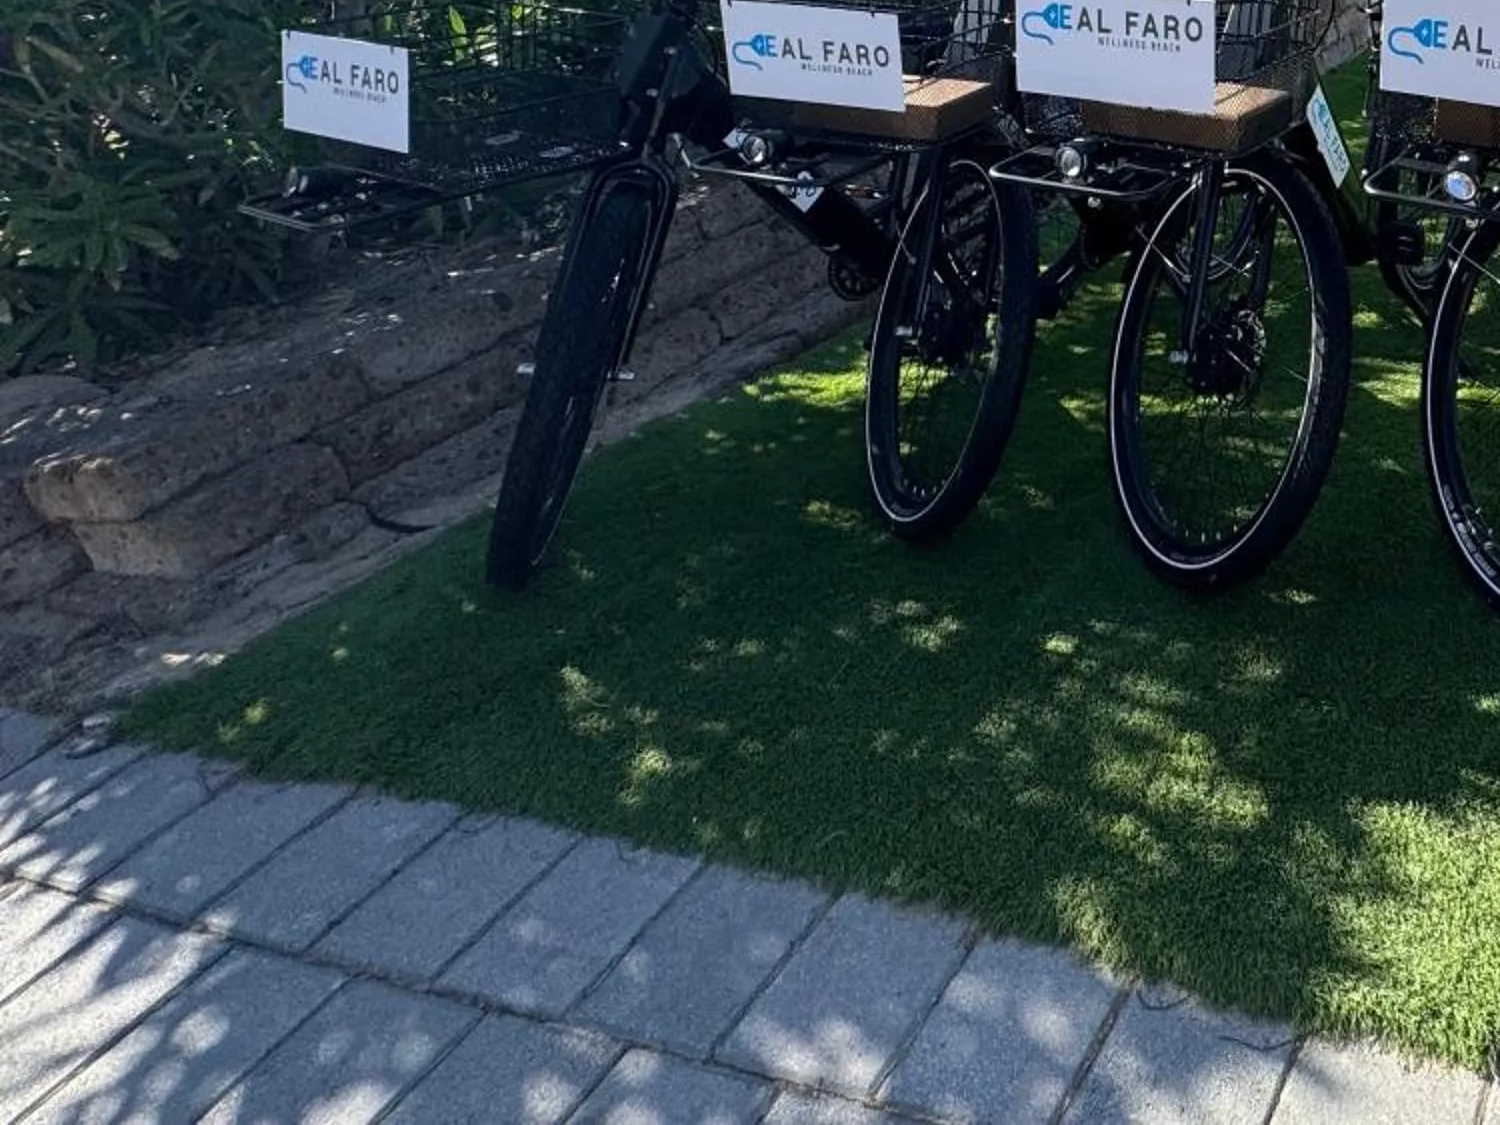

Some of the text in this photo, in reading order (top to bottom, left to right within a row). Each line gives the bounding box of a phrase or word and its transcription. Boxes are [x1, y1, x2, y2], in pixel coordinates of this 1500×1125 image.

[1125, 11, 1203, 42] FARO
[822, 40, 890, 68] FARO
[351, 65, 399, 94] FARO
